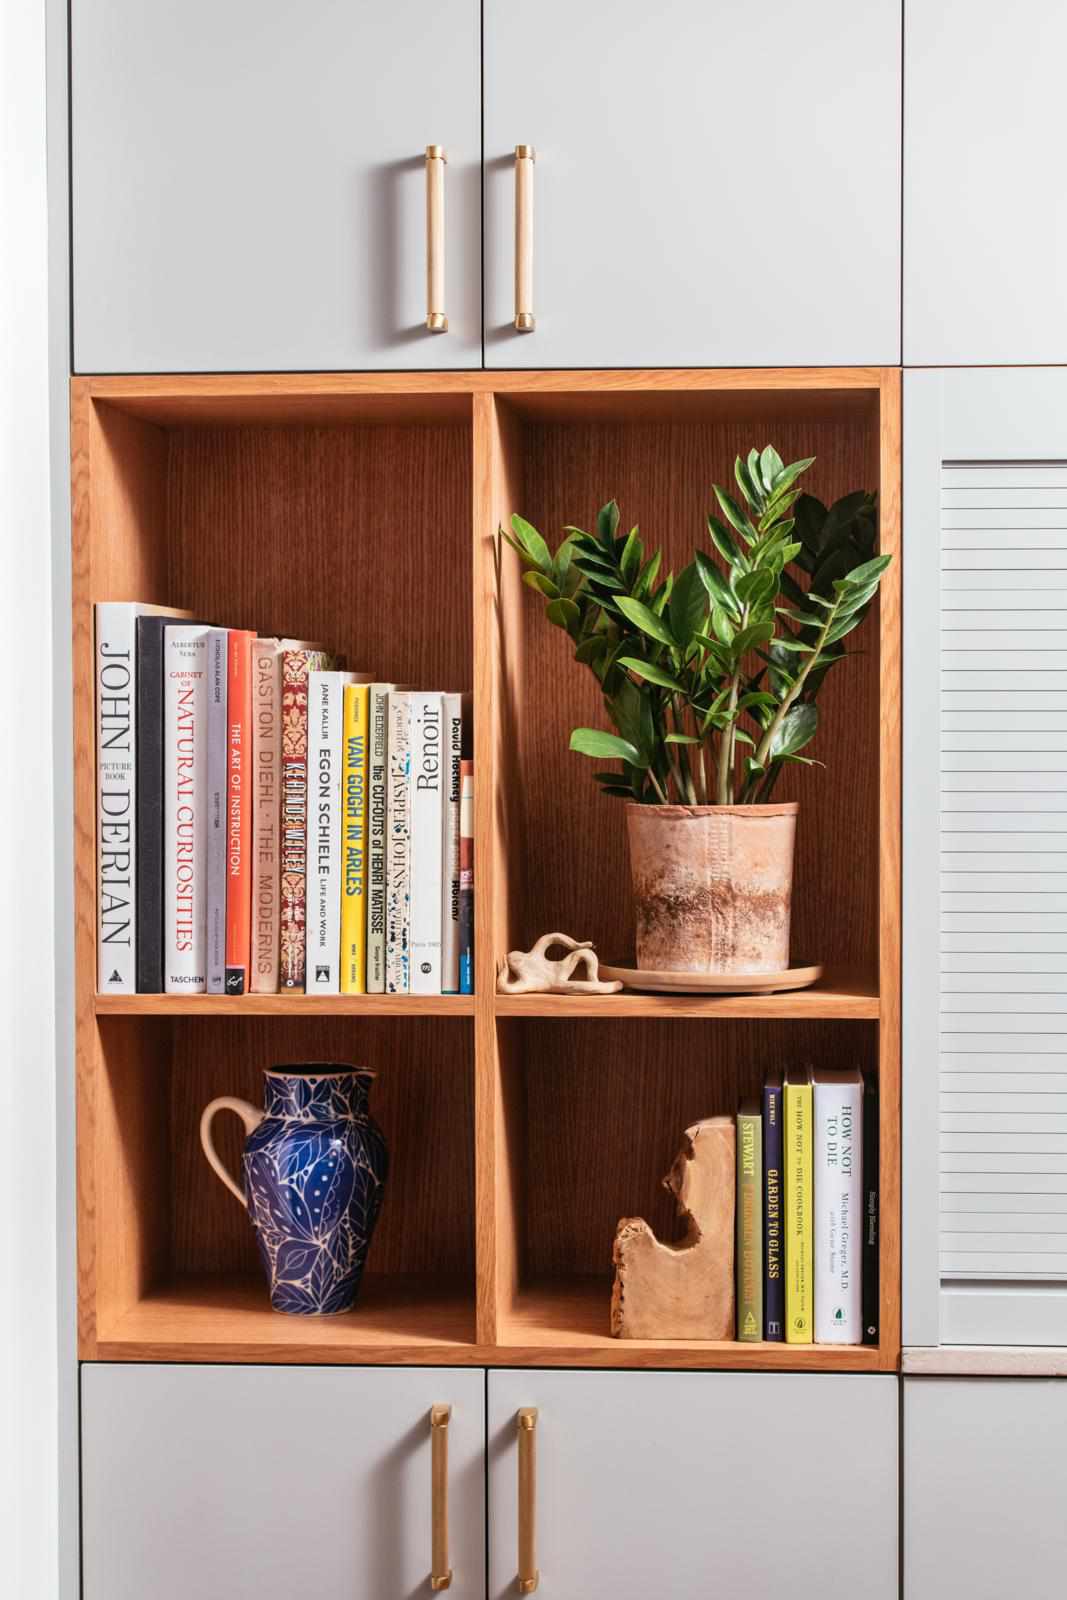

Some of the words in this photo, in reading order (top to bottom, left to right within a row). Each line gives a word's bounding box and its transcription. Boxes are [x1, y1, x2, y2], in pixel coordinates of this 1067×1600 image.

[99, 642, 131, 752] JOHN
[257, 657, 274, 738] GASTON
[320, 684, 329, 706] JANE
[375, 693, 384, 713] JOHN
[231, 724, 241, 744] THE
[320, 708, 329, 740] KALLIR
[375, 715, 384, 757] ELDERFIELD
[451, 718, 461, 751] David
[176, 688, 195, 802] NATURAL
[231, 749, 241, 770] ART
[347, 736, 364, 768] VAN
[416, 704, 439, 792] Renoir
[100, 763, 132, 771] PICTURE
[105, 773, 128, 781] BOOK
[231, 774, 241, 791] OF
[259, 751, 274, 809] DIEHL
[319, 749, 331, 798] EGON
[373, 765, 383, 781] the
[449, 754, 461, 802] Hockney
[285, 762, 305, 825] KEHINDE
[347, 774, 364, 818] GOGH
[372, 784, 385, 836] CUT-OUTS
[391, 771, 407, 832] JASPER
[230, 794, 241, 876] INSTRUCTION
[259, 824, 274, 864] THE
[285, 830, 305, 874] WILEY
[318, 801, 330, 875] SCHIELE
[346, 824, 363, 841] IN
[372, 840, 384, 849] of
[100, 789, 131, 948] DERIAN
[176, 806, 194, 952] CURIOSITIES
[345, 847, 362, 897] ARLES
[371, 853, 384, 887] HENRI
[391, 835, 406, 889] JOHNS
[318, 878, 327, 897] LIFE
[451, 880, 461, 921] Abrams
[257, 875, 274, 974] MODERNS
[318, 900, 327, 918] AND
[371, 888, 384, 935] MATISSE
[318, 919, 327, 947] WORK
[170, 976, 204, 984] TASCHEN
[827, 1115, 838, 1137] TO
[841, 1106, 853, 1142] HOW
[743, 1122, 754, 1177] STEWART
[827, 1142, 838, 1168] DIE
[841, 1145, 852, 1177] NOT
[768, 1169, 779, 1219] GARDEN
[841, 1192, 849, 1230] Michael
[768, 1221, 779, 1237] TO
[768, 1239, 779, 1279] GLASS
[839, 1232, 849, 1267] Greger,
[840, 1269, 849, 1293] M.D.
